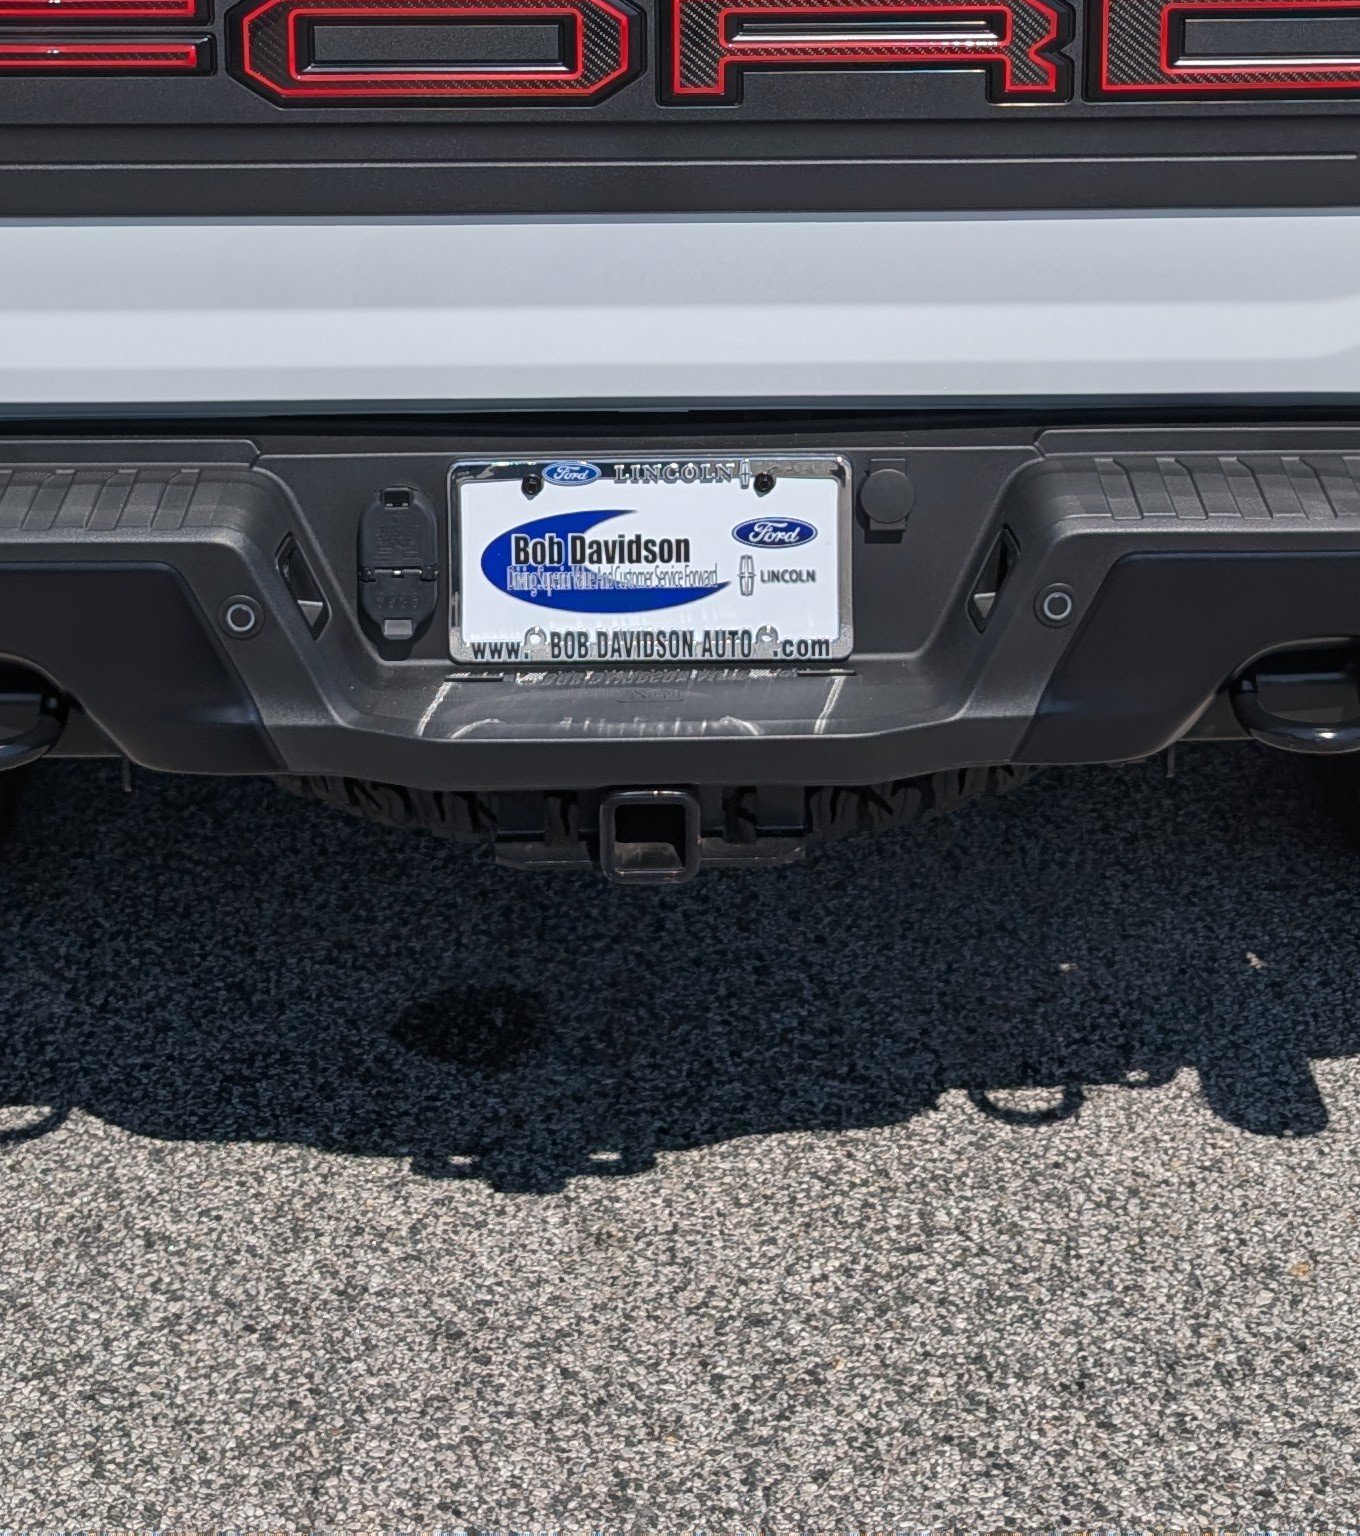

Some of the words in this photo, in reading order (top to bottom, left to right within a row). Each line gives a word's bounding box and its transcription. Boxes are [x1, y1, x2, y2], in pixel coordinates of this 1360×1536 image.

[613, 464, 736, 483] LINCOLN
[746, 521, 803, 544] Ford
[513, 534, 564, 565] Bob
[570, 534, 691, 565] Davidson
[615, 565, 654, 588] Customer
[655, 564, 684, 588] Service
[684, 563, 719, 588] Forward
[760, 568, 817, 584] LINCOLN
[472, 641, 531, 660] www.
[550, 632, 589, 659] BOB
[597, 630, 694, 659] DAVIDSON
[701, 629, 752, 658] AUTO
[772, 637, 831, 658] .com
